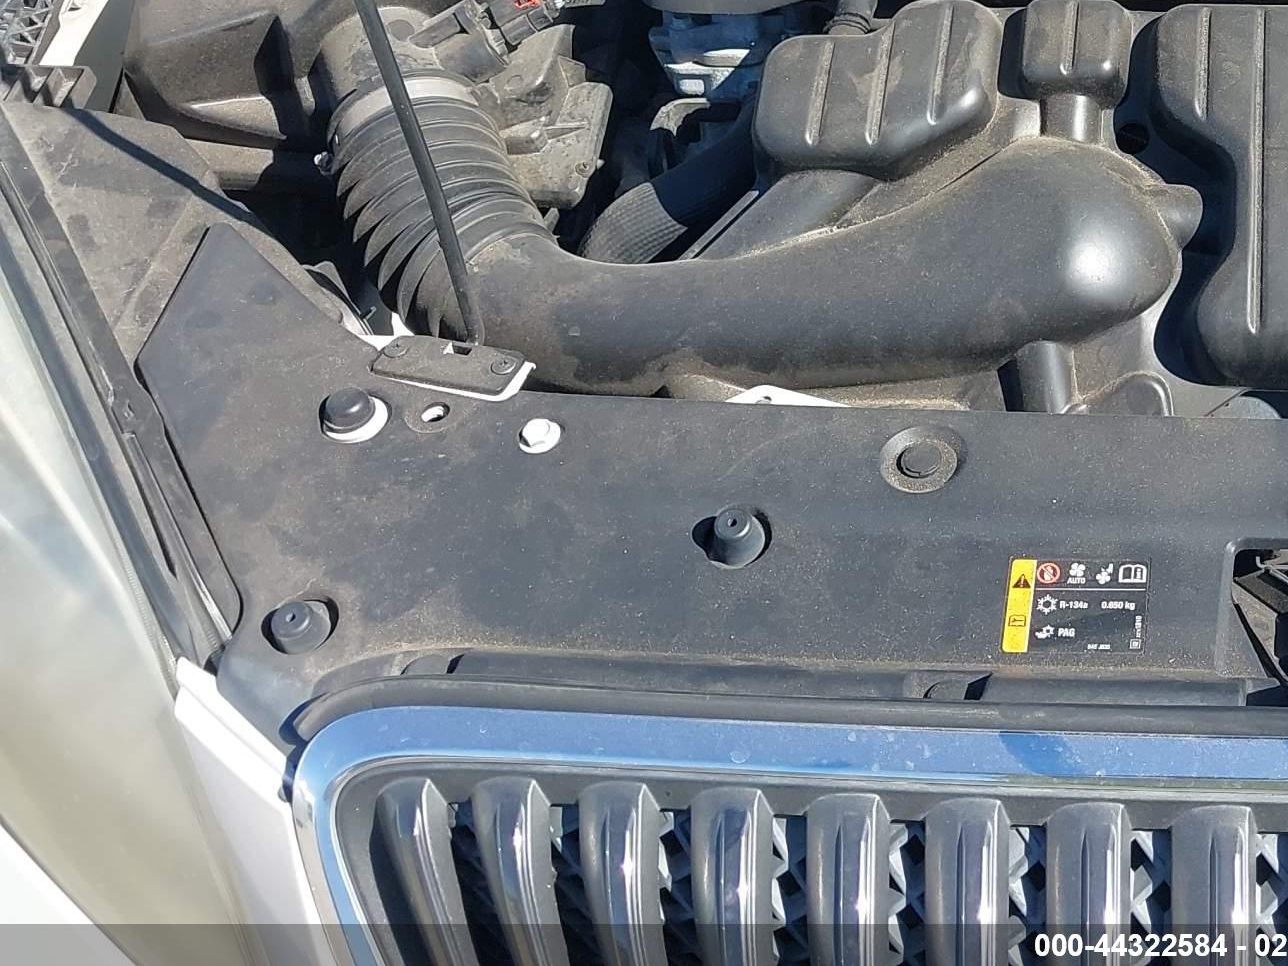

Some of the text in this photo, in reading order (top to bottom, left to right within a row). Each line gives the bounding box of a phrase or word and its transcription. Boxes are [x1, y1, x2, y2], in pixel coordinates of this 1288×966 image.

[1059, 600, 1135, 610] R-134a 0.650 kg
[1058, 628, 1075, 637] PAG
